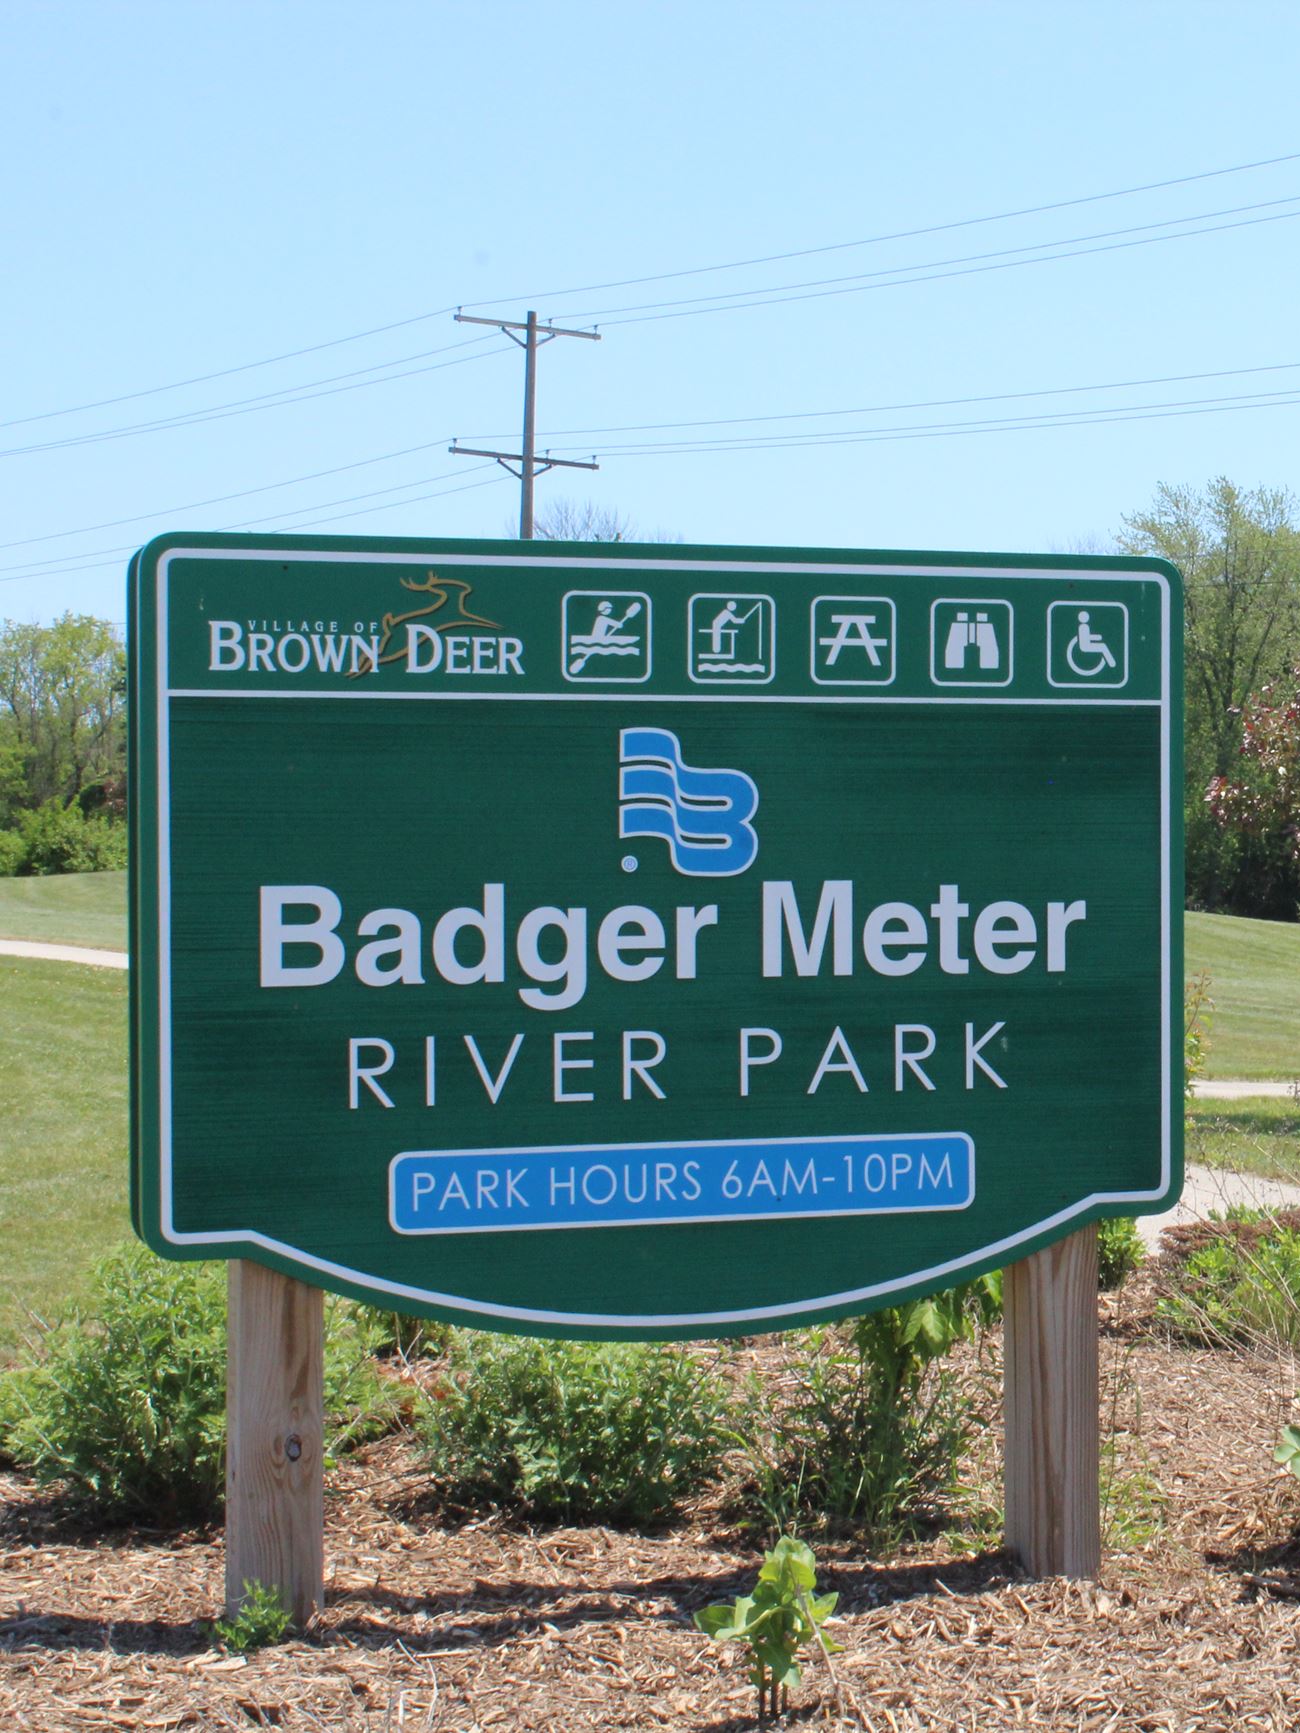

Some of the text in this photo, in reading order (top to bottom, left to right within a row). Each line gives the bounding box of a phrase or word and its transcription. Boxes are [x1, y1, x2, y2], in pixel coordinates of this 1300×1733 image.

[247, 620, 378, 634] VILLAGE OF
[405, 623, 525, 675] DEER
[259, 880, 1087, 1011] Badger Meter
[349, 1021, 1009, 1109] RIVER PARK
[411, 1151, 954, 1211] PARK HOURS 6AM-10PM
